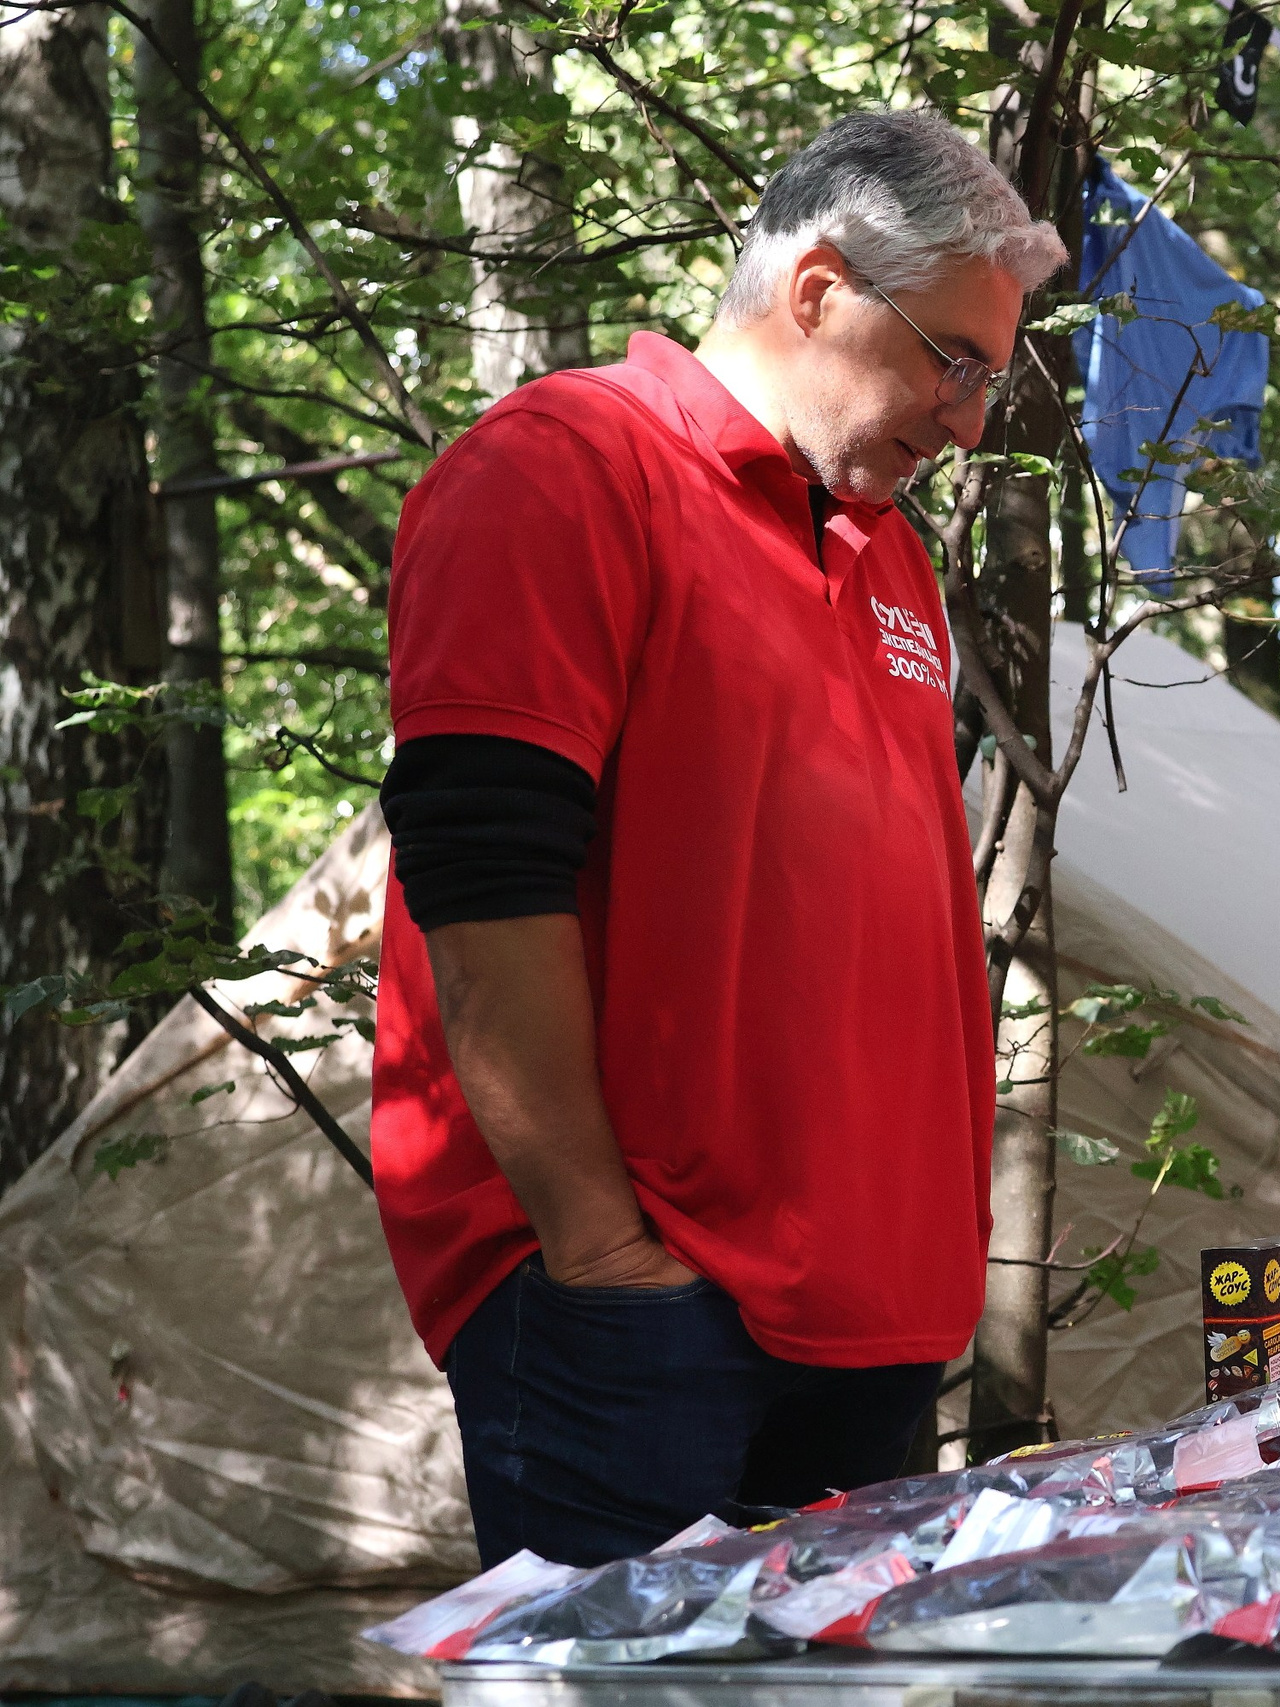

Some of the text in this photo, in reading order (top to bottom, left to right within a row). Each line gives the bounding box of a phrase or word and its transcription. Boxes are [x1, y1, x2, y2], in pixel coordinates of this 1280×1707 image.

[886, 652, 936, 688] 300%
[1214, 1271, 1244, 1286] ЖАР-
[1220, 1280, 1248, 1297] СОУС
